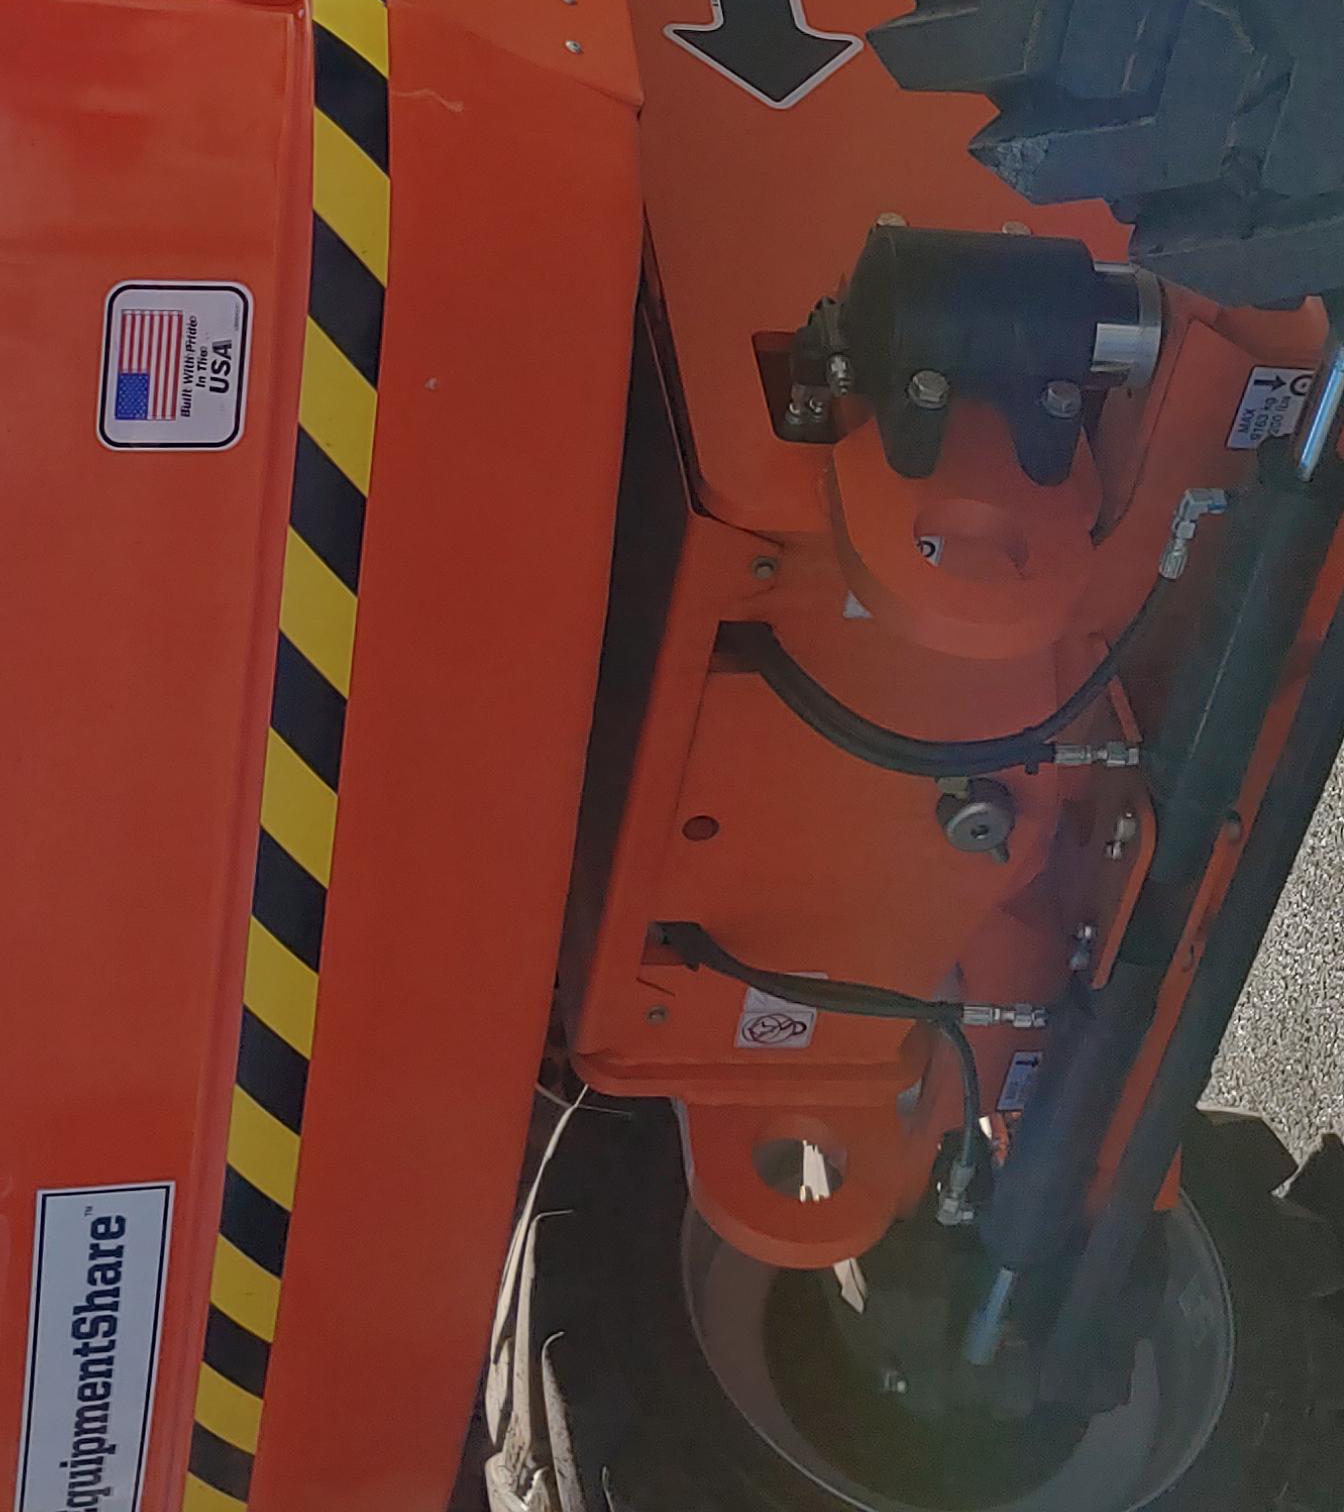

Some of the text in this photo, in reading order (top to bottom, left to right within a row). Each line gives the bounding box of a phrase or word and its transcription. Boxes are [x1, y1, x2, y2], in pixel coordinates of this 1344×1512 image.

[180, 316, 198, 417] Built With Pride
[196, 347, 208, 388] In The
[209, 339, 232, 393] USA
[1238, 408, 1256, 433] MAX
